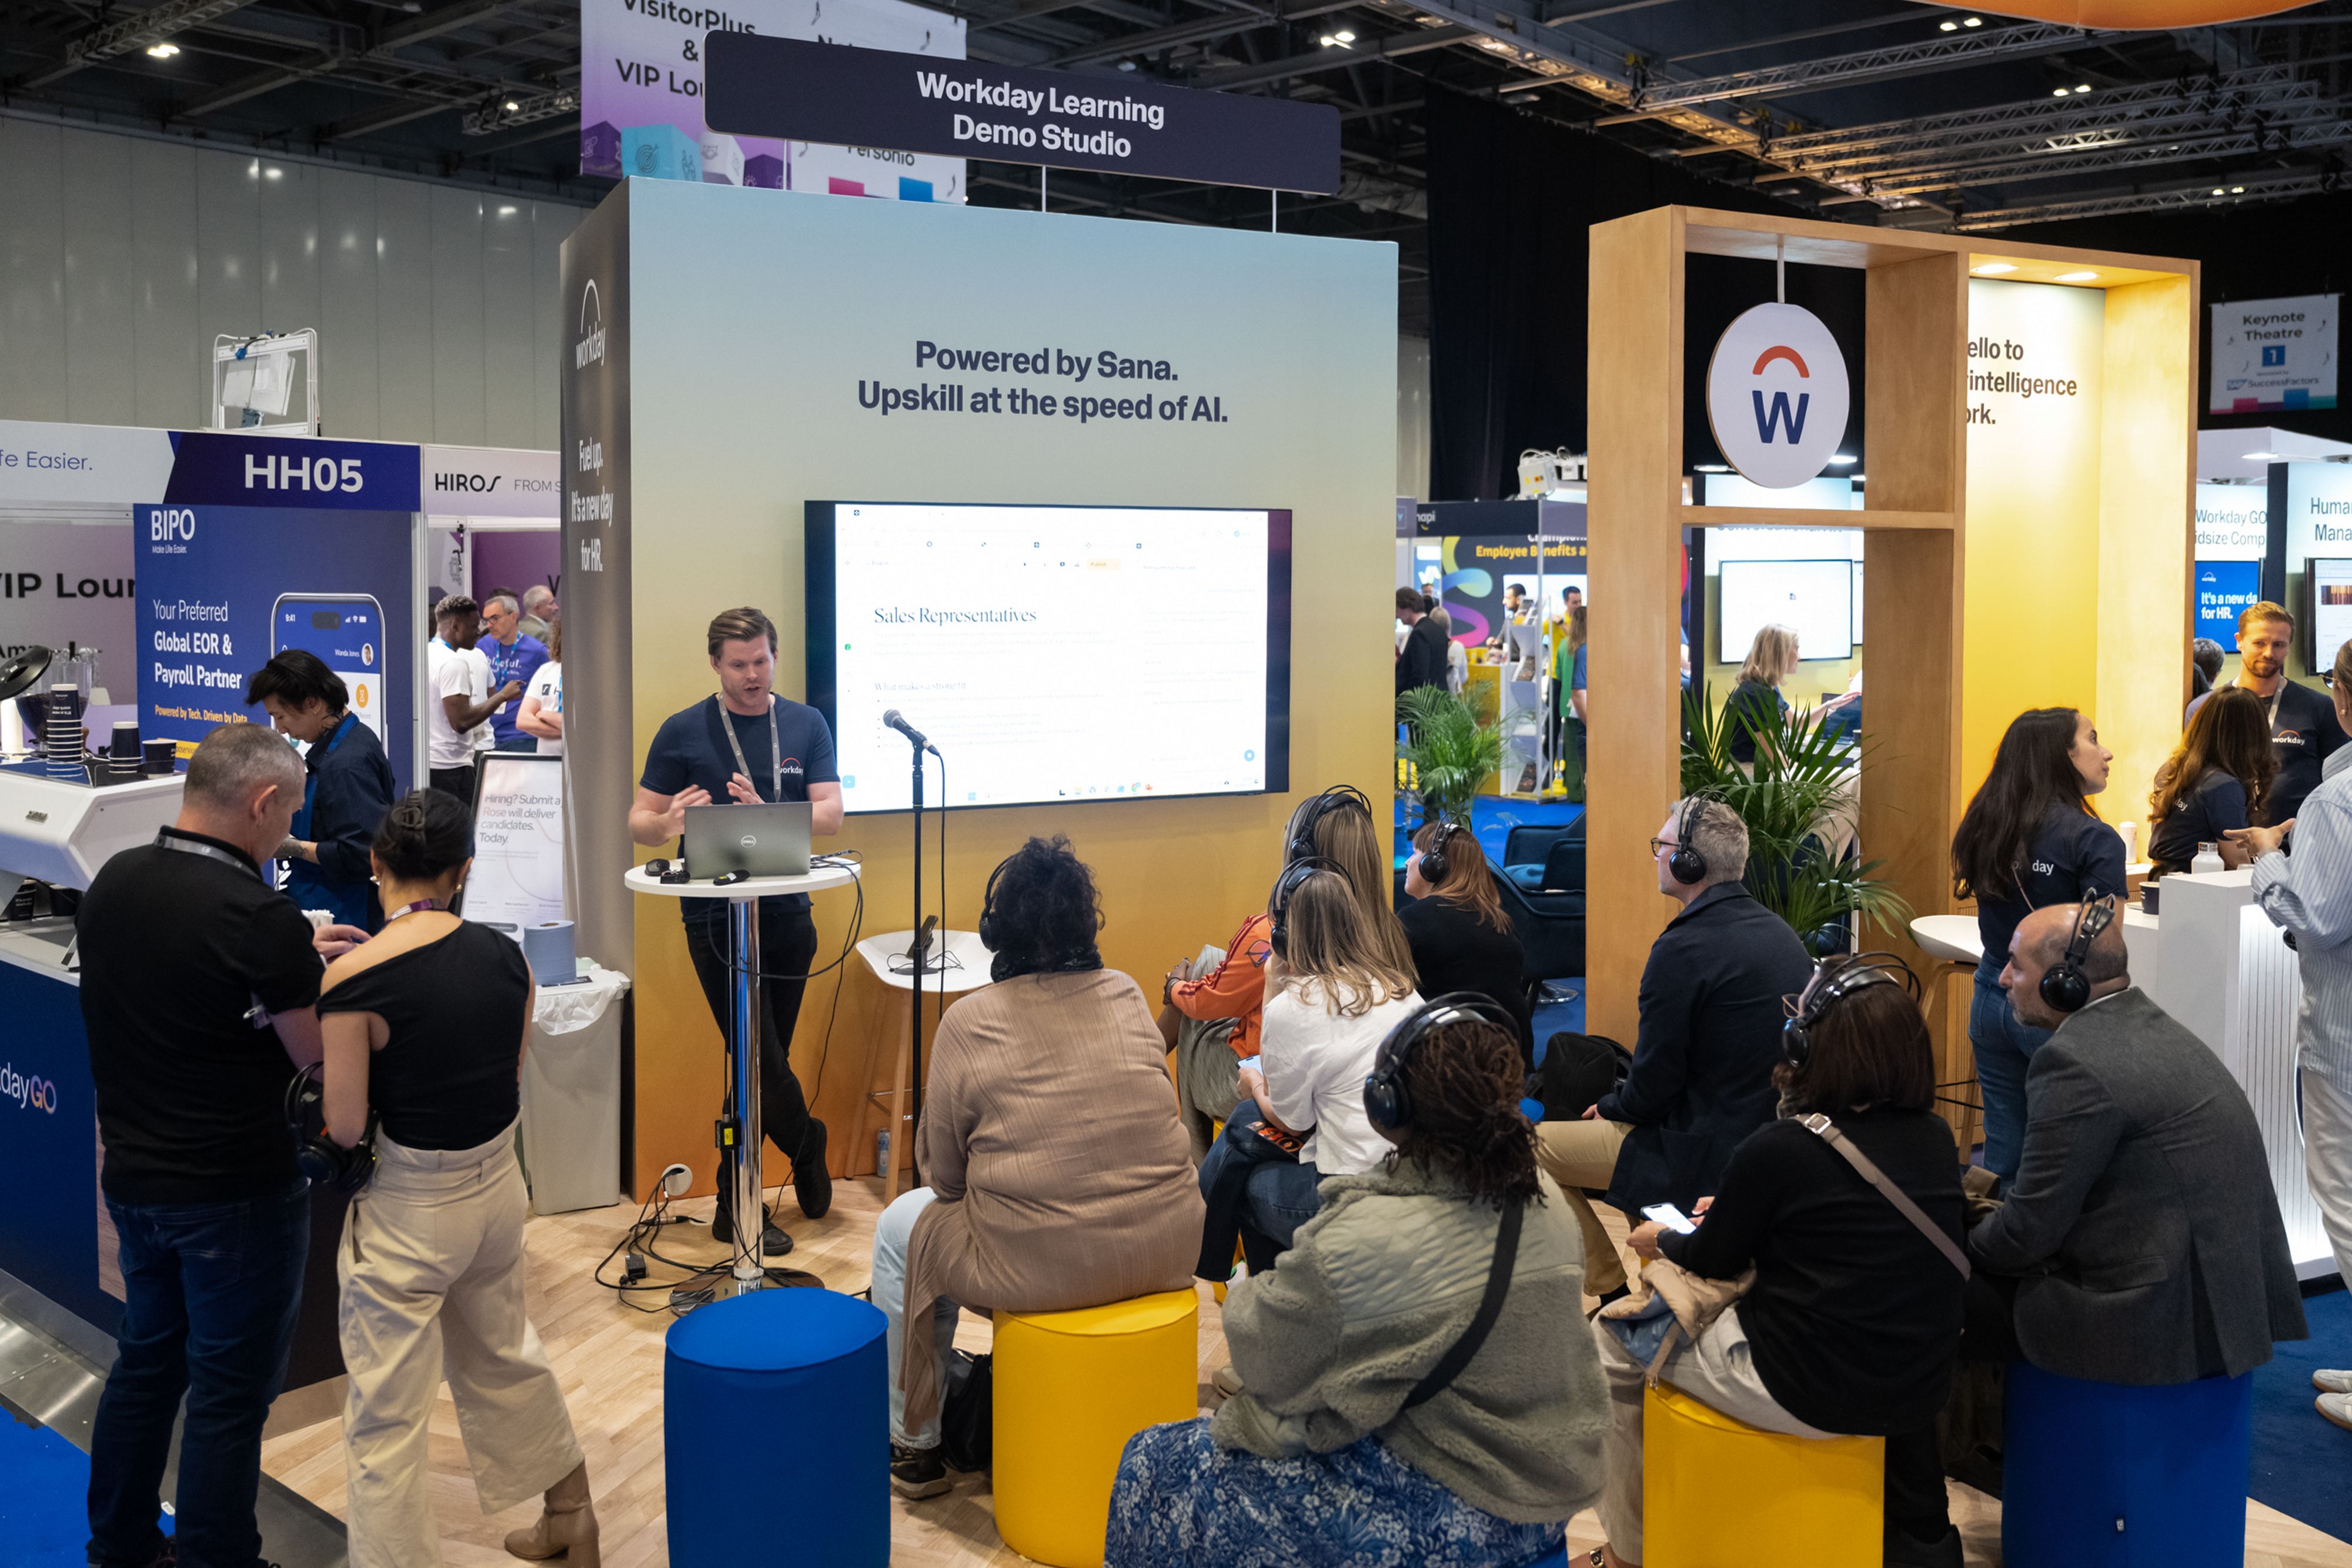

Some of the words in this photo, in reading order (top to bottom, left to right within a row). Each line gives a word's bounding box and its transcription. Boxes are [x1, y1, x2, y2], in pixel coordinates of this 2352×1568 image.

[683, 39, 699, 62] &
[616, 58, 660, 86] VIP
[669, 71, 703, 98] Lo
[917, 71, 1044, 115] Workday
[1050, 87, 1164, 130] Learning
[954, 114, 1037, 148] Demo
[1042, 124, 1131, 158] Studio
[848, 147, 915, 166] ersonio
[2243, 312, 2305, 326] Keynote
[2244, 329, 2303, 341] Theatre
[576, 322, 606, 369] workday
[1967, 337, 2000, 359] ello
[2004, 339, 2024, 360] to
[916, 340, 1050, 375] Powered
[1057, 349, 1093, 382] by
[1097, 350, 1178, 381] Sana.
[2270, 349, 2277, 363] 1
[1970, 369, 2077, 399] intelligence
[2248, 377, 2319, 388] SuccessFactors
[858, 380, 963, 416] Upskill
[970, 387, 1002, 414] at
[1007, 388, 1057, 416] the
[1063, 393, 1152, 423] speed
[1159, 395, 1188, 422] of
[1191, 396, 1228, 423] AI.
[27, 451, 92, 470] Easier.
[579, 437, 592, 472] Fuel
[593, 441, 604, 476] up.
[245, 453, 364, 493] HH05
[514, 479, 552, 492] FROM
[572, 490, 581, 522] It's
[581, 497, 587, 521] a
[587, 495, 599, 521] new
[600, 486, 613, 527] day
[2311, 497, 2352, 514] Huma
[151, 509, 195, 541] BIPO
[2196, 509, 2247, 526] Workday
[2249, 510, 2267, 524] GO
[2231, 531, 2265, 548] Comp
[152, 545, 165, 554] Make
[581, 539, 591, 571] for
[591, 539, 603, 572] HR.
[1476, 545, 1527, 559] Employee
[1530, 545, 1577, 557] Bnefits
[0, 573, 42, 598] IP
[2201, 592, 2216, 604] It's
[2217, 594, 2224, 604] a
[2226, 594, 2244, 604] new
[153, 599, 176, 619] Your
[179, 600, 228, 621] Preferred
[285, 614, 296, 622] 9:41
[874, 607, 915, 623] Sales
[920, 607, 1037, 626] Representatives
[2201, 607, 2216, 619] for
[2216, 607, 2233, 619] HR.
[154, 630, 191, 653] Global
[193, 632, 219, 654] EOR
[222, 634, 233, 655] &
[335, 649, 348, 657] Wanda
[487, 655, 522, 668] hieful.
[155, 662, 194, 688] Payroll
[197, 665, 242, 689] Partner
[874, 683, 897, 691] What
[898, 682, 924, 691] makes
[155, 704, 179, 718] Powered
[180, 707, 187, 721] by
[188, 708, 202, 720] Tech.
[203, 710, 223, 723] Driven
[224, 711, 232, 724] by
[233, 712, 248, 723] Data
[2272, 736, 2305, 745] workday
[485, 794, 517, 806] Hiring?
[519, 794, 553, 805] Submit
[483, 807, 506, 817] Rose
[509, 808, 523, 818] will
[524, 808, 556, 819] deliver
[481, 820, 534, 830] candidates.
[0, 1062, 56, 1114] dayGO
